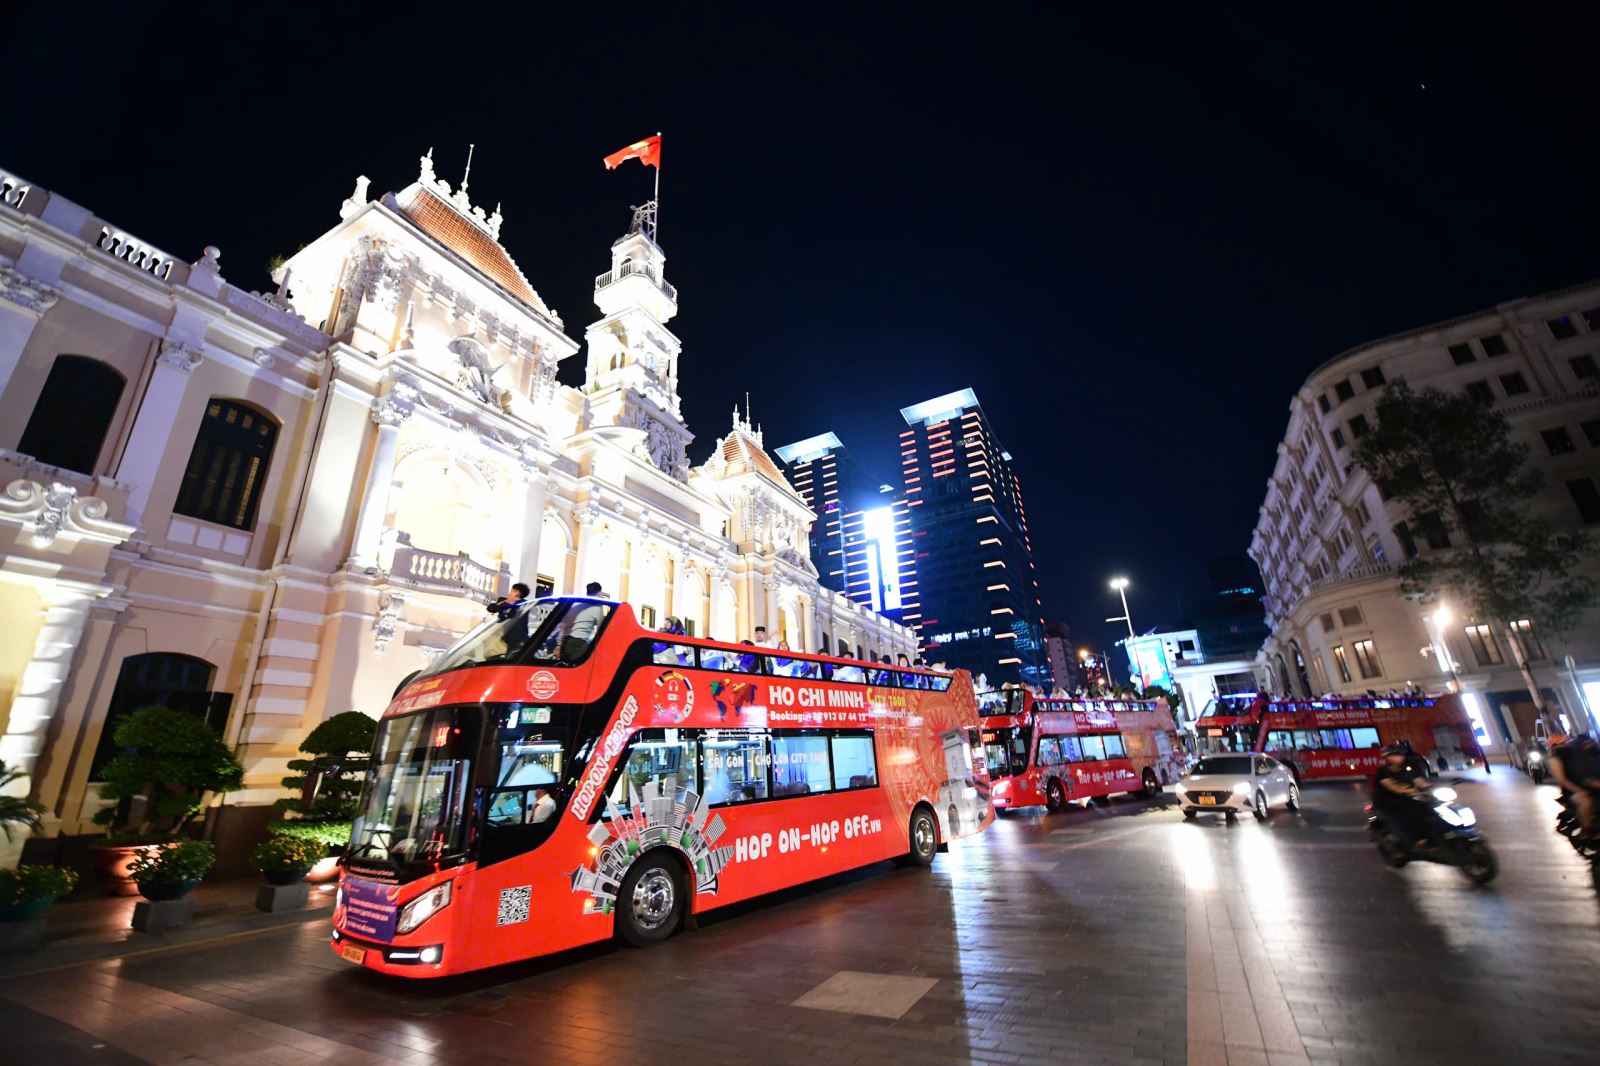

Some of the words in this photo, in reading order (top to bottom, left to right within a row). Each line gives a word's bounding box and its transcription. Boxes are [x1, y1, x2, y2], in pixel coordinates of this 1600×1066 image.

[768, 685, 795, 706] HO
[798, 687, 825, 707] CHI
[828, 689, 864, 708] MINH
[824, 712, 836, 721] 913
[838, 712, 847, 721] 67
[848, 712, 857, 721] 44
[571, 779, 596, 821] HOP
[619, 694, 639, 726] OFF
[726, 752, 745, 768] GÒN
[735, 832, 773, 864] HOP
